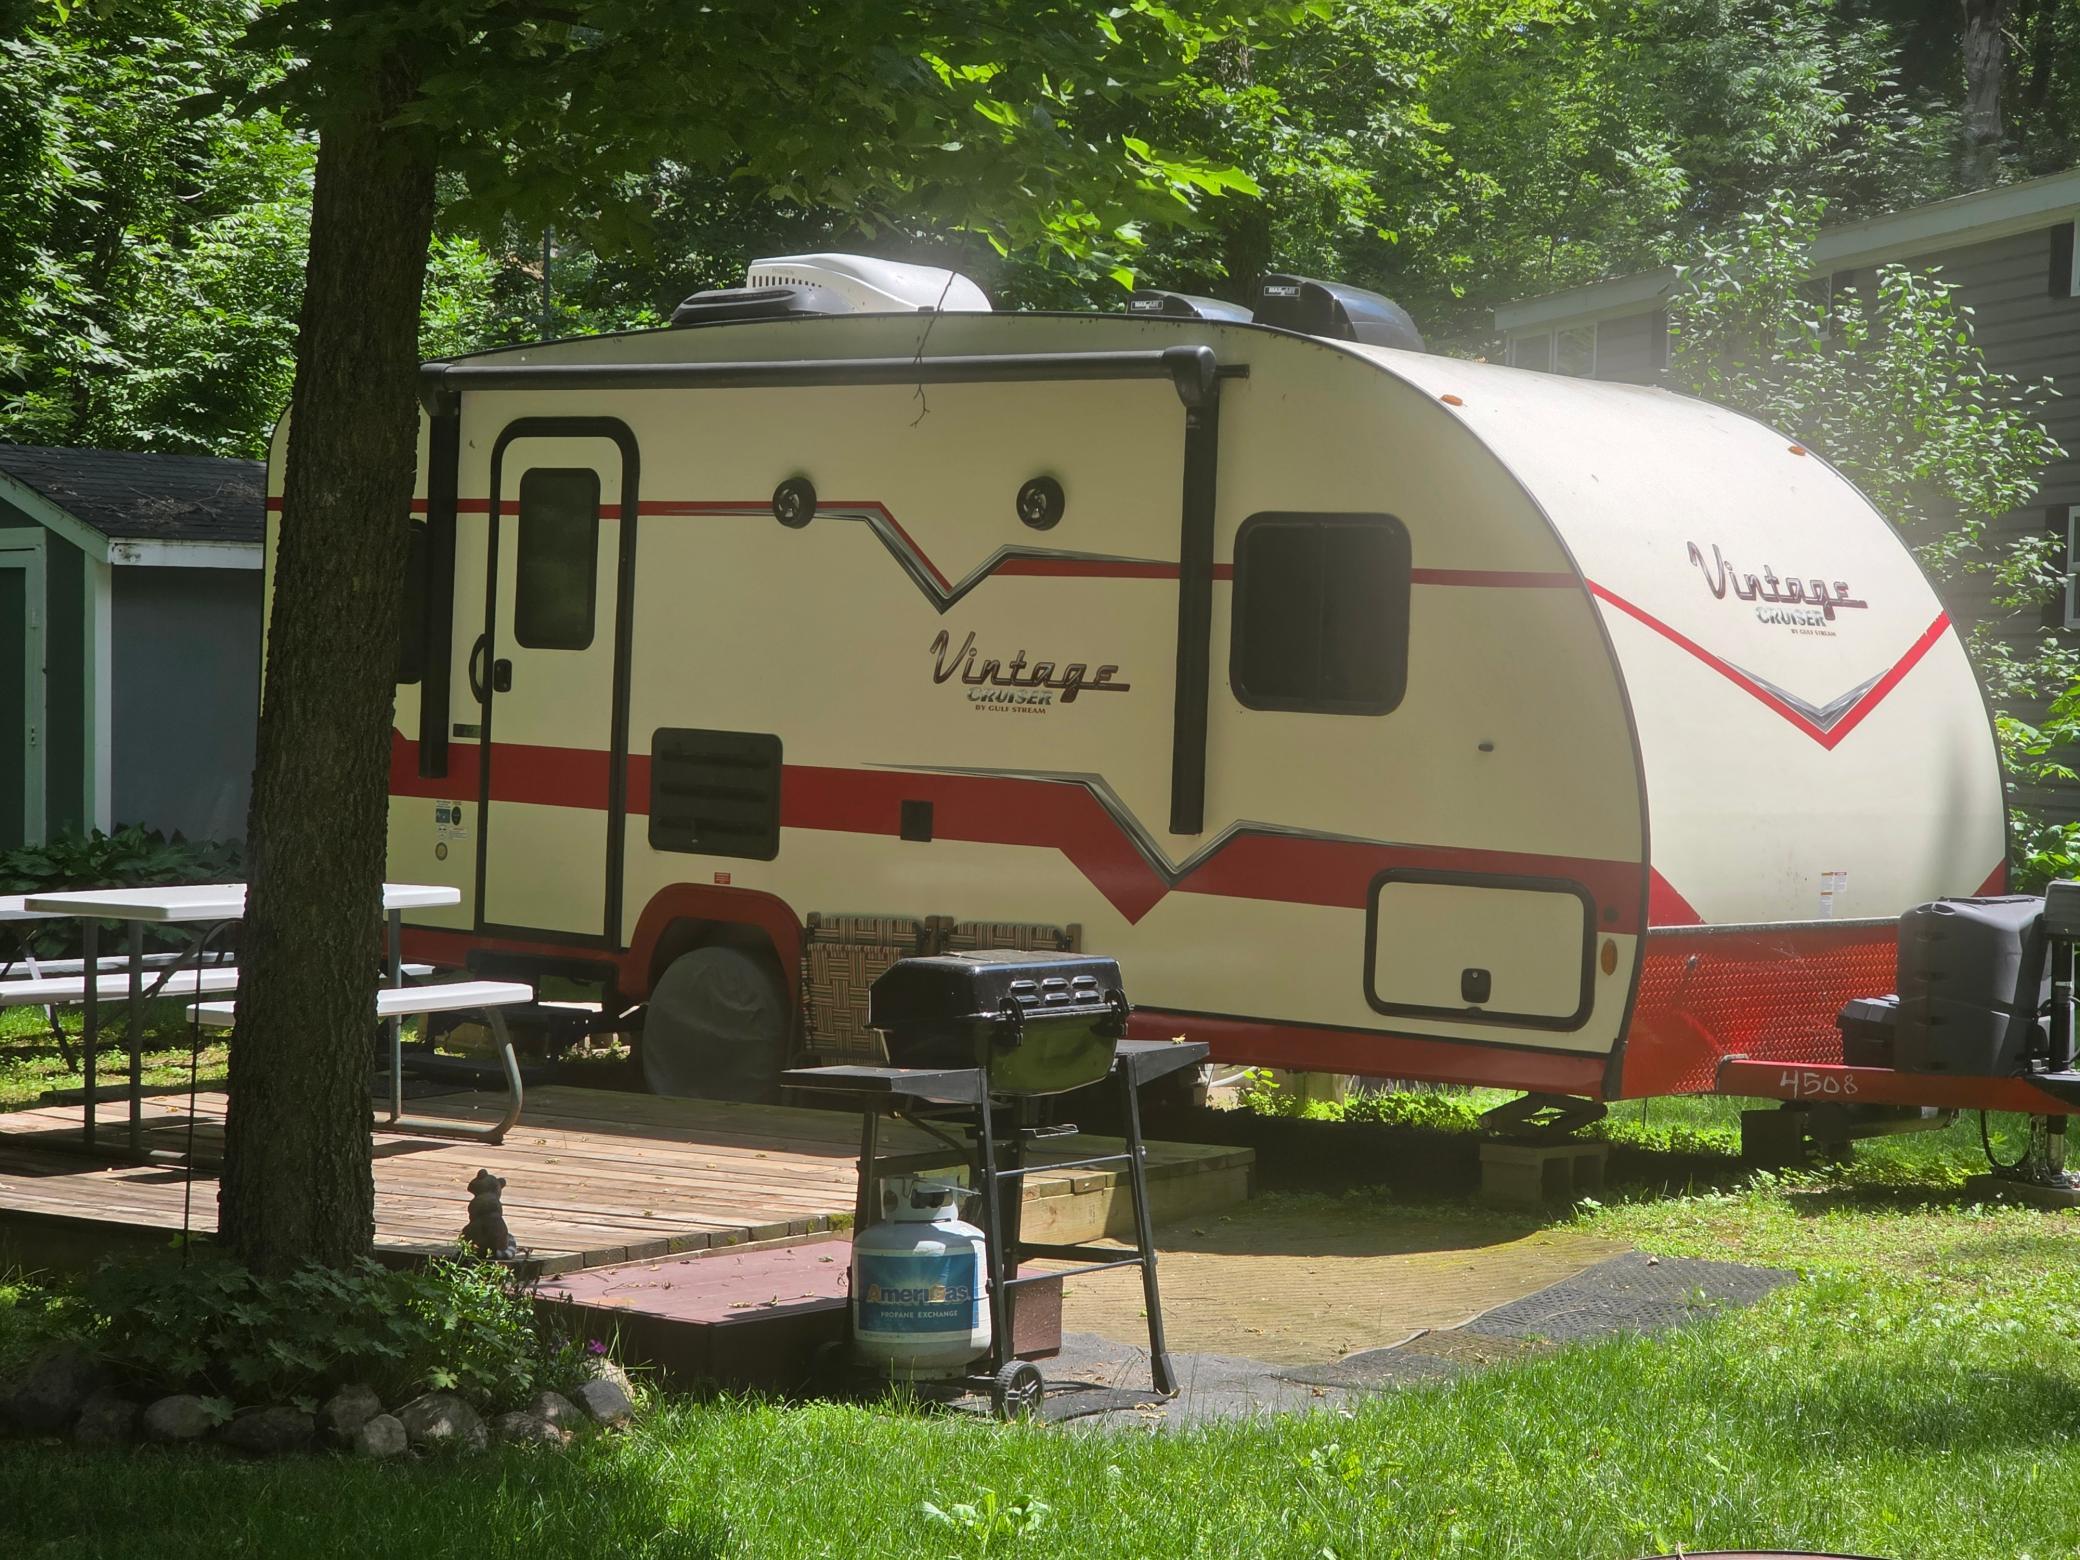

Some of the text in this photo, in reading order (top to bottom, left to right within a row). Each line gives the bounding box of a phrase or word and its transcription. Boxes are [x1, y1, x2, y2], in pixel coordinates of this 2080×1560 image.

[1686, 540, 1868, 621] Vintage
[1755, 606, 1827, 627] CRUISER
[929, 629, 1131, 703] Vintage
[966, 686, 1054, 706] CRUISER
[1011, 706, 1047, 714] STREAM
[1780, 1069, 1858, 1099] 4508
[866, 1283, 968, 1304] AmeriGas
[880, 1310, 958, 1319] PROPANE EXCHANGE
